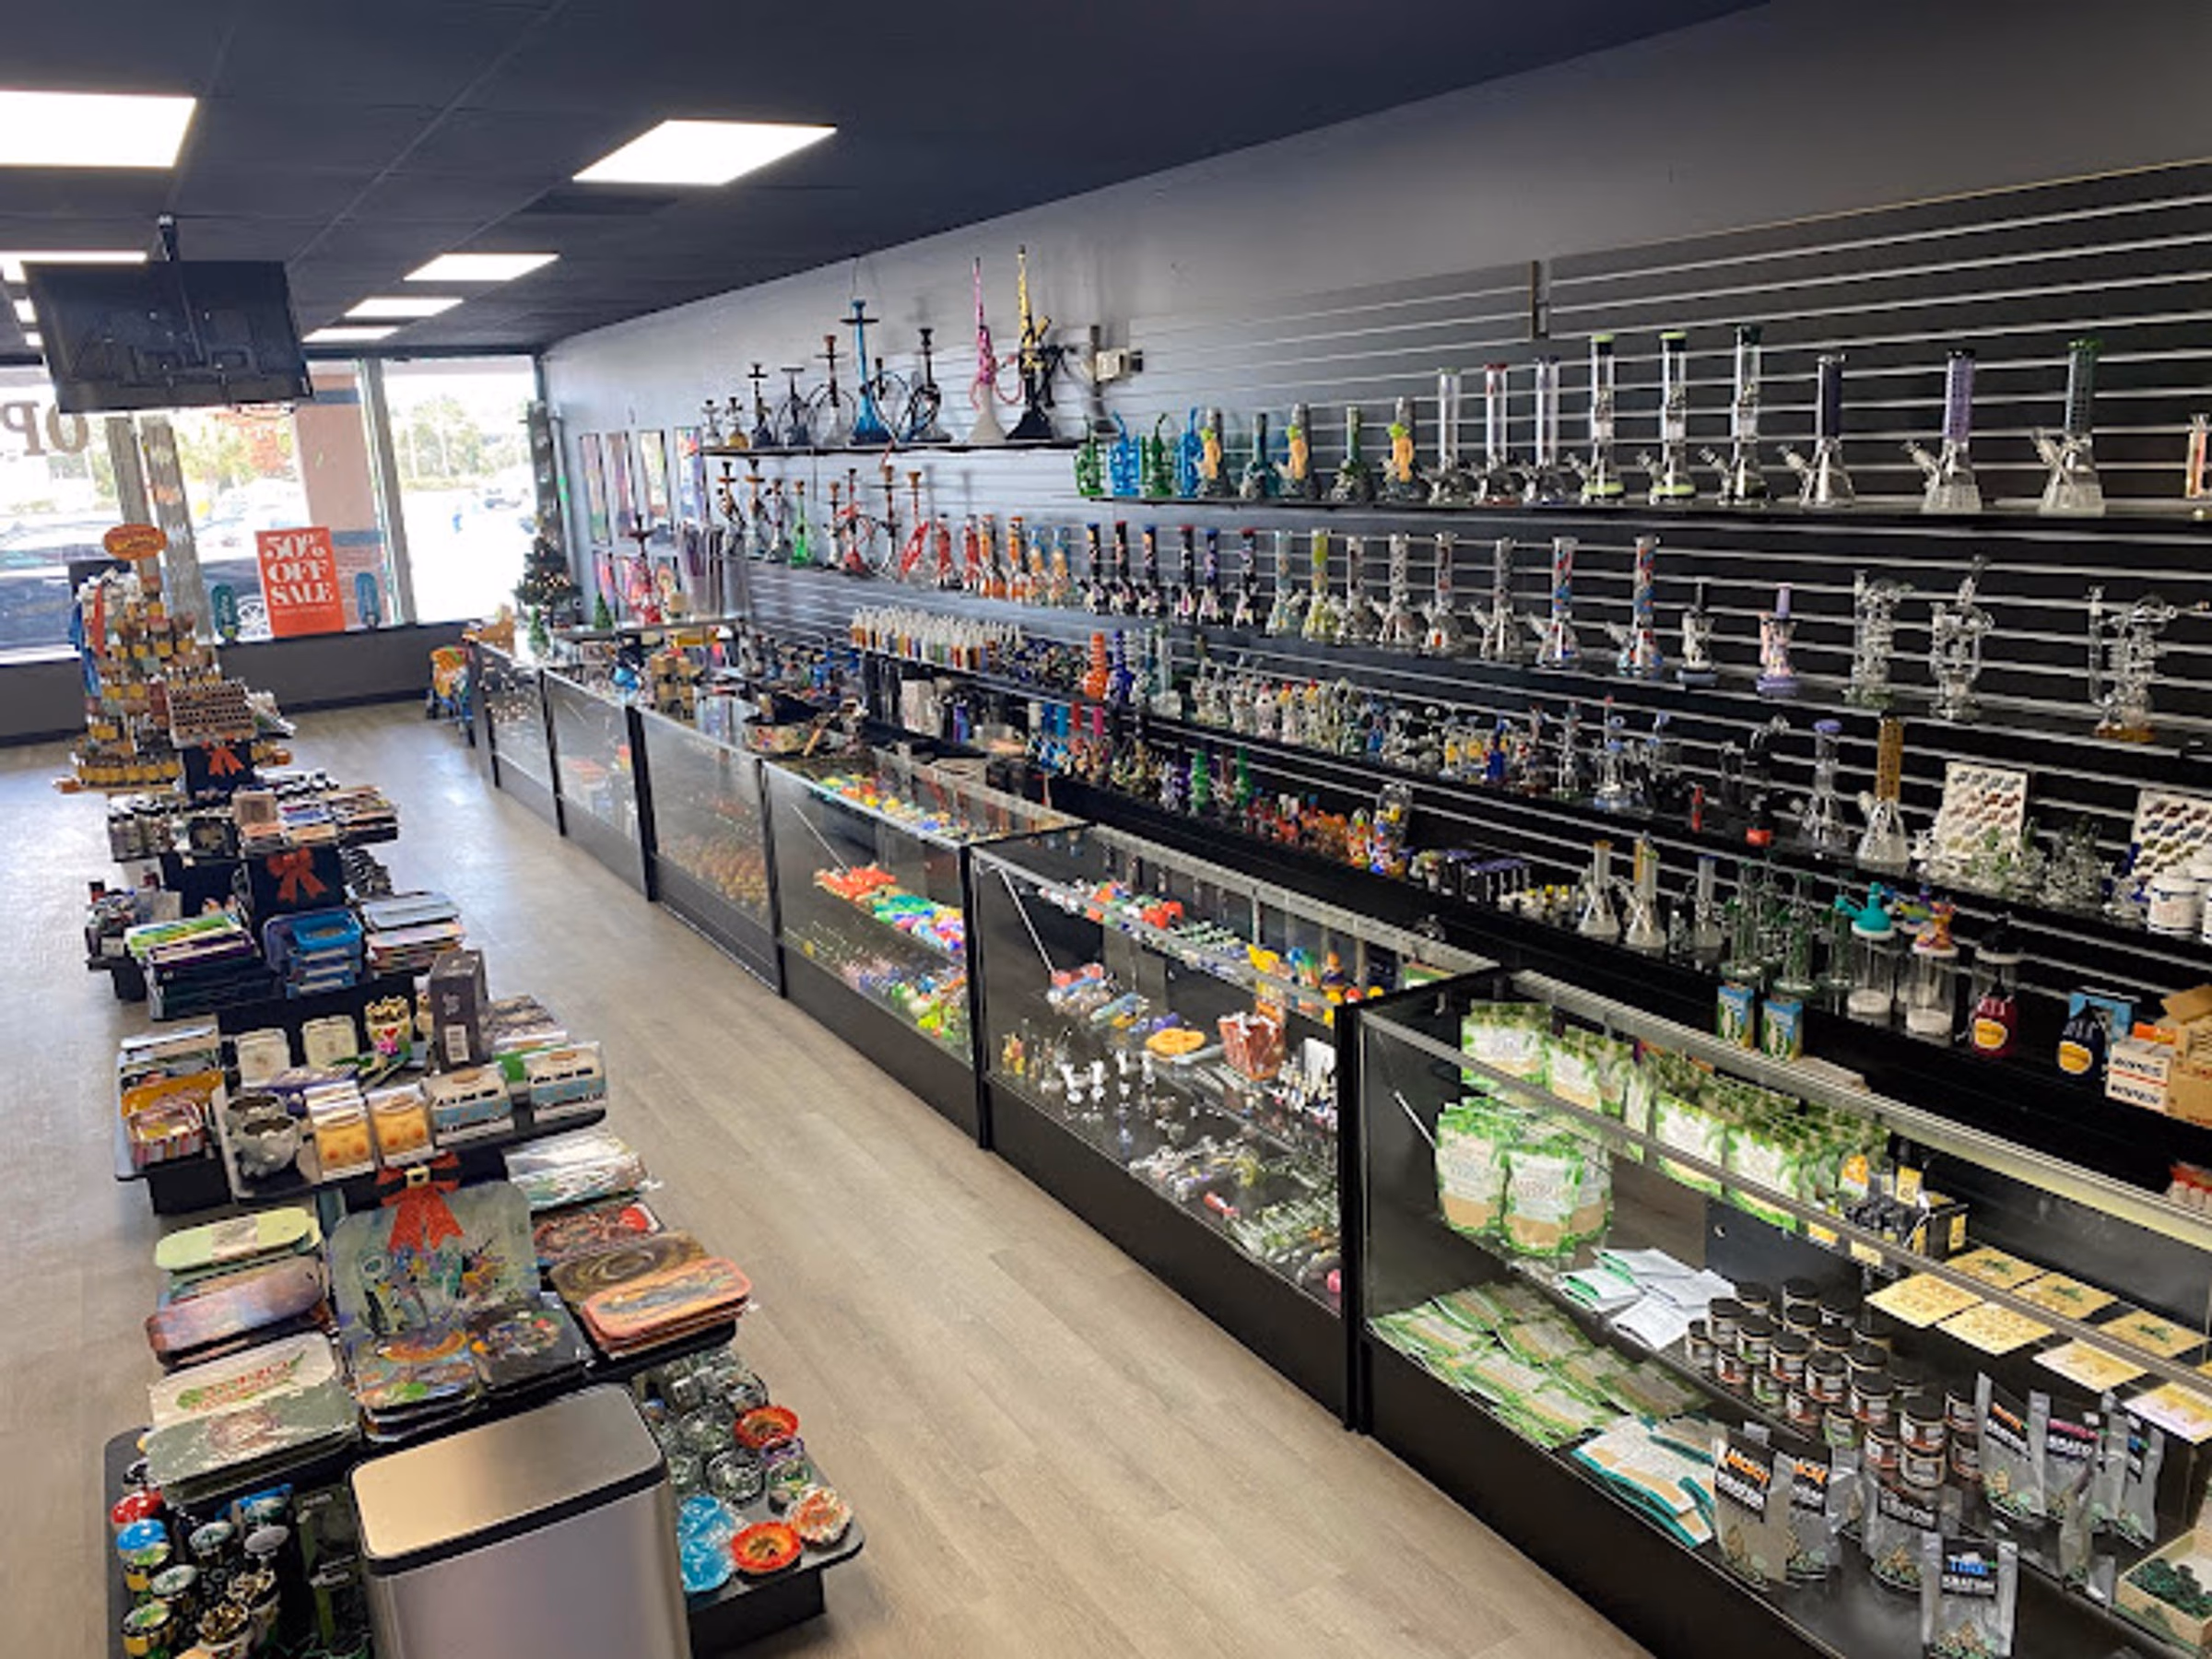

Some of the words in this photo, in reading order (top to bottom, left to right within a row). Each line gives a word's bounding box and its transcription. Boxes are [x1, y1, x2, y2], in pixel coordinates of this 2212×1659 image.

[265, 534, 326, 559] 50%
[267, 559, 328, 583] OFF
[270, 582, 334, 606] SALE
